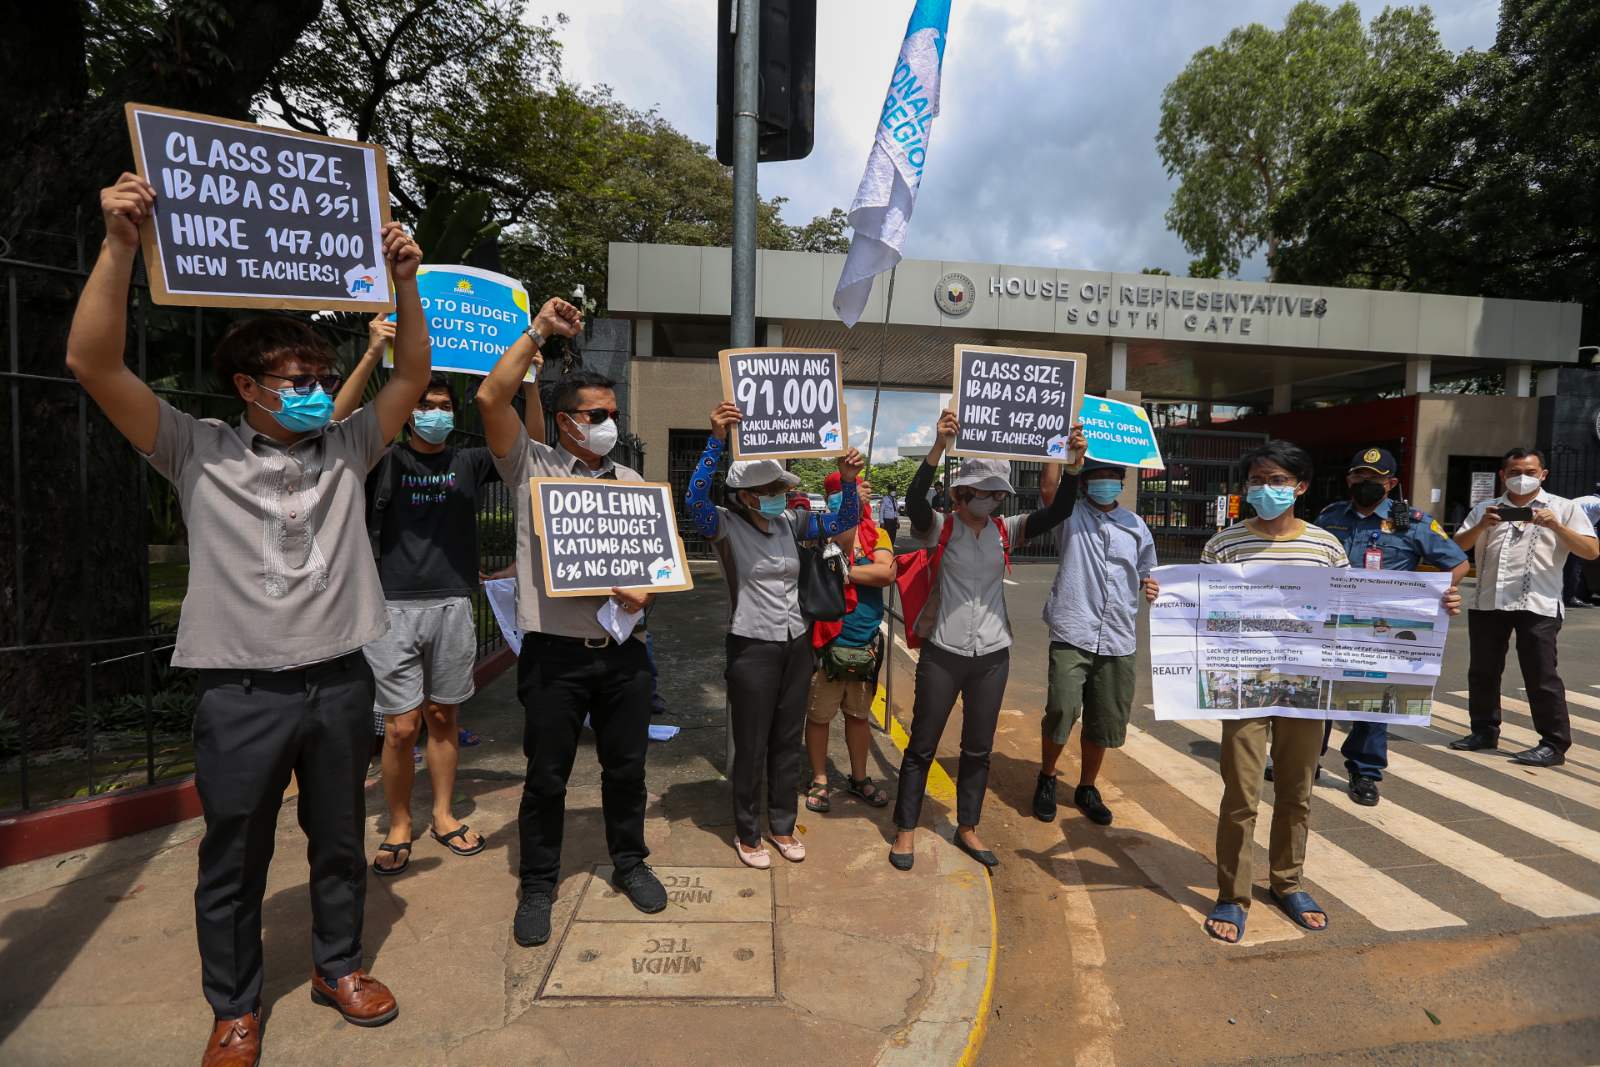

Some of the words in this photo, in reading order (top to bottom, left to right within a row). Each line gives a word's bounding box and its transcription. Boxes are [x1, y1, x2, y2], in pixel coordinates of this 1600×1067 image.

[891, 57, 932, 134] ONAL
[880, 94, 926, 177] REGIO
[166, 132, 272, 174] CLASS
[278, 150, 352, 190] SIZE,
[162, 168, 262, 210] IBABA
[269, 183, 310, 214] SA
[316, 192, 359, 222] 35!
[170, 213, 250, 250] HIRE
[264, 228, 364, 260] 147,000
[176, 254, 227, 277] NEW
[236, 258, 340, 285] TEACHERS!
[989, 276, 1070, 301] HOUSE
[1080, 282, 1110, 304] OF
[1120, 284, 1328, 318] REPRESENTATIVES
[420, 297, 431, 309] O
[434, 298, 457, 312] TO
[461, 302, 518, 324] BUDGET
[1067, 305, 1159, 329] SOUTH
[1184, 314, 1252, 336] GATE
[432, 317, 474, 333] CUTS
[478, 323, 498, 336] TO
[428, 335, 509, 355] UCATION
[737, 358, 799, 376] PUNUAN
[802, 358, 830, 376] ANG
[971, 360, 1020, 380] CLASS
[1022, 365, 1064, 388] SIZE,
[737, 377, 834, 416] 91,000
[966, 380, 1012, 402] IBABA
[1014, 385, 1037, 404] SA
[1040, 390, 1065, 408] 35!
[742, 419, 802, 432] KAKULANGAN
[802, 418, 814, 429] SA
[964, 404, 1001, 426] HIRE
[1008, 411, 1064, 432] 147,000
[1078, 416, 1114, 429] SAFELY
[1117, 422, 1142, 434] OPEN
[962, 428, 988, 442] NEW
[992, 430, 1046, 448] TEACHERS!
[1082, 430, 1122, 442] CHOOLS
[550, 490, 661, 519] DOBLEHIN,
[552, 518, 594, 534] EDUC
[598, 518, 656, 535] BUDGET
[554, 538, 640, 556] KATUMBAS
[642, 538, 664, 554] NG
[556, 562, 582, 581] 6%
[584, 560, 607, 576] NG
[610, 559, 645, 576] GDP!
[1152, 666, 1192, 675] REALITY
[668, 890, 712, 904] MMD
[646, 938, 692, 954] TEC
[632, 957, 702, 974] MMDA
